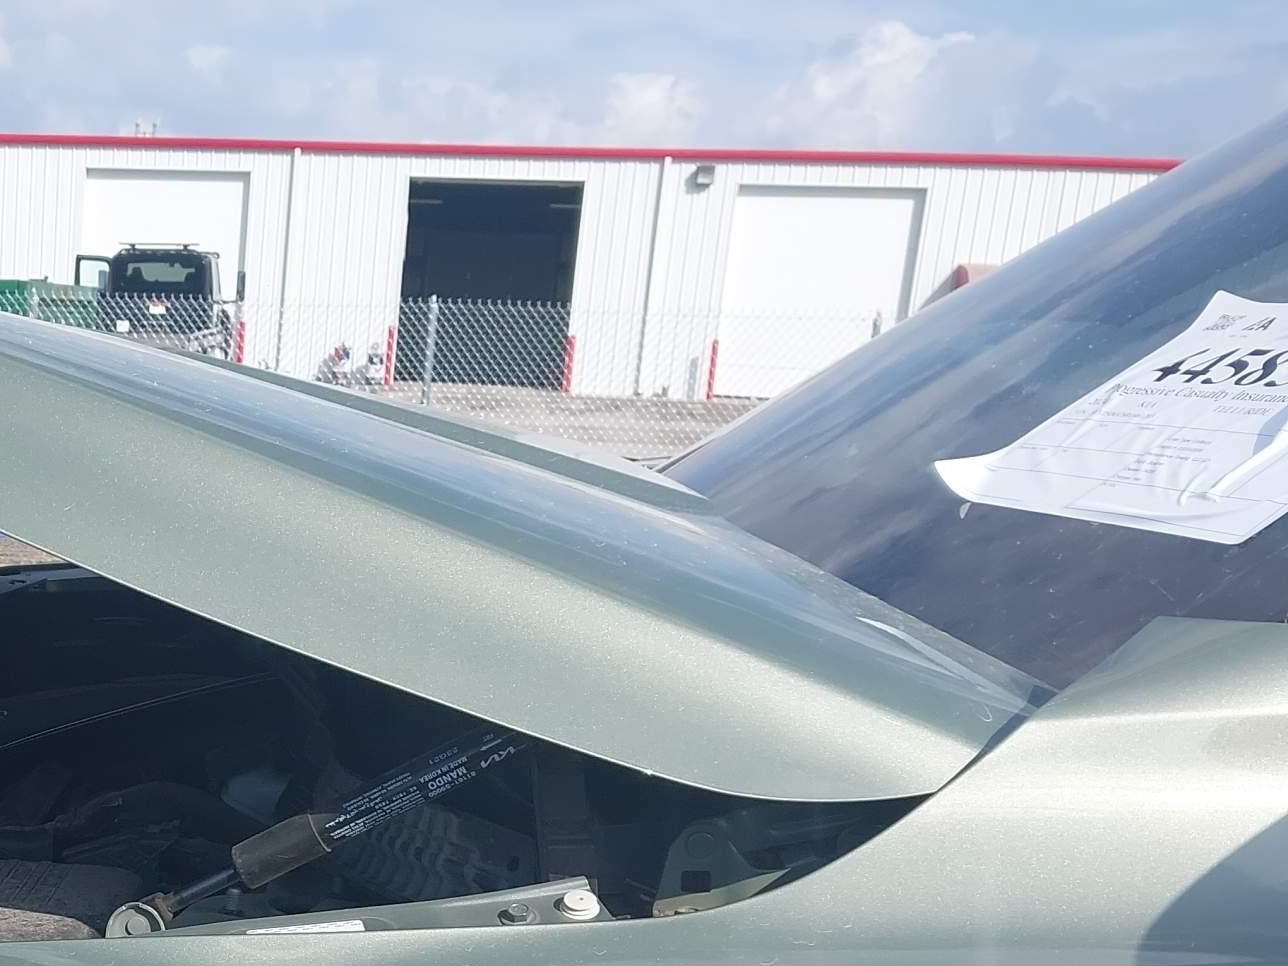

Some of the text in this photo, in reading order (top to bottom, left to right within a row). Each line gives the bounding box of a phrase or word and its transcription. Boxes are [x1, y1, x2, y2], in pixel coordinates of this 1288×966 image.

[1175, 387, 1229, 402] Casualty
[1230, 389, 1288, 403] Insuran
[428, 766, 468, 790] MANDO
